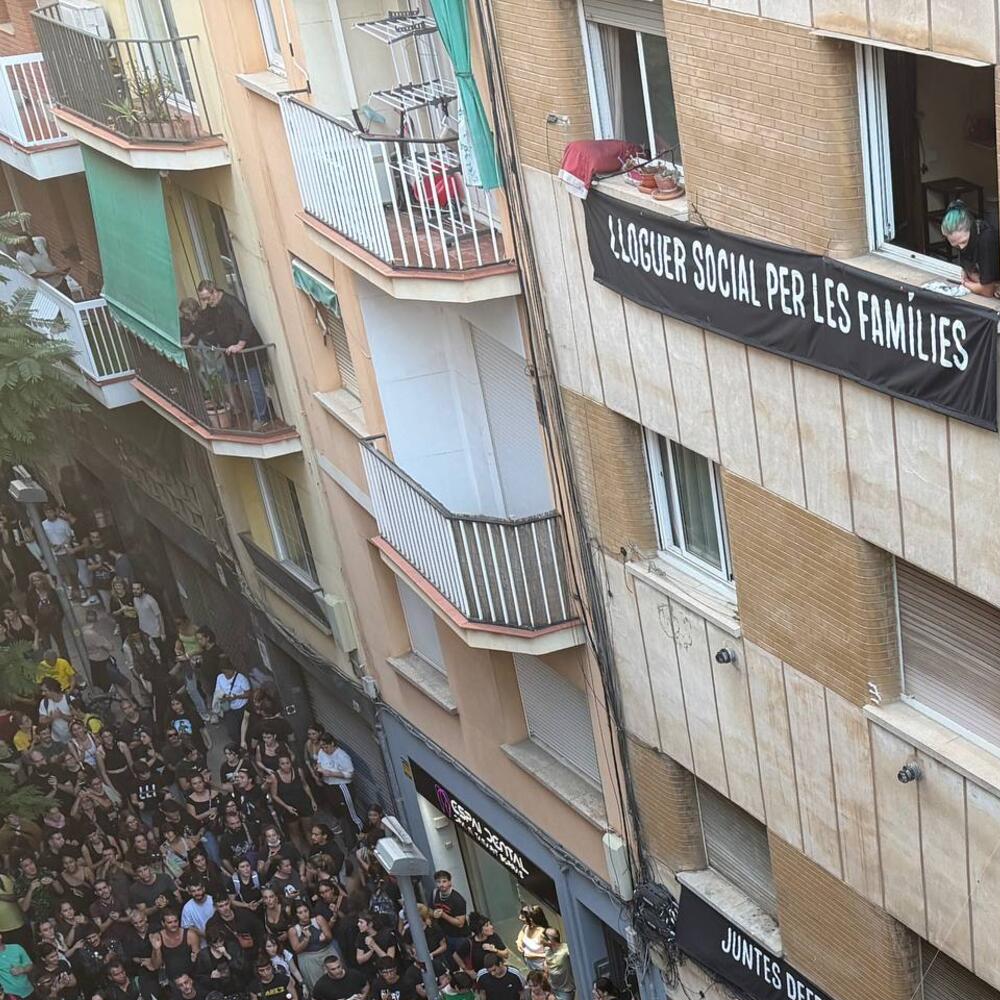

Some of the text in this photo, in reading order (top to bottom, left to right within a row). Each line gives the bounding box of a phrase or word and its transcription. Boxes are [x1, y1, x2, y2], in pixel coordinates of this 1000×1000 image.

[608, 214, 969, 372] LLOGUER SOCIAL PER LES FAMÍLIES
[721, 926, 783, 990] JUNTES
